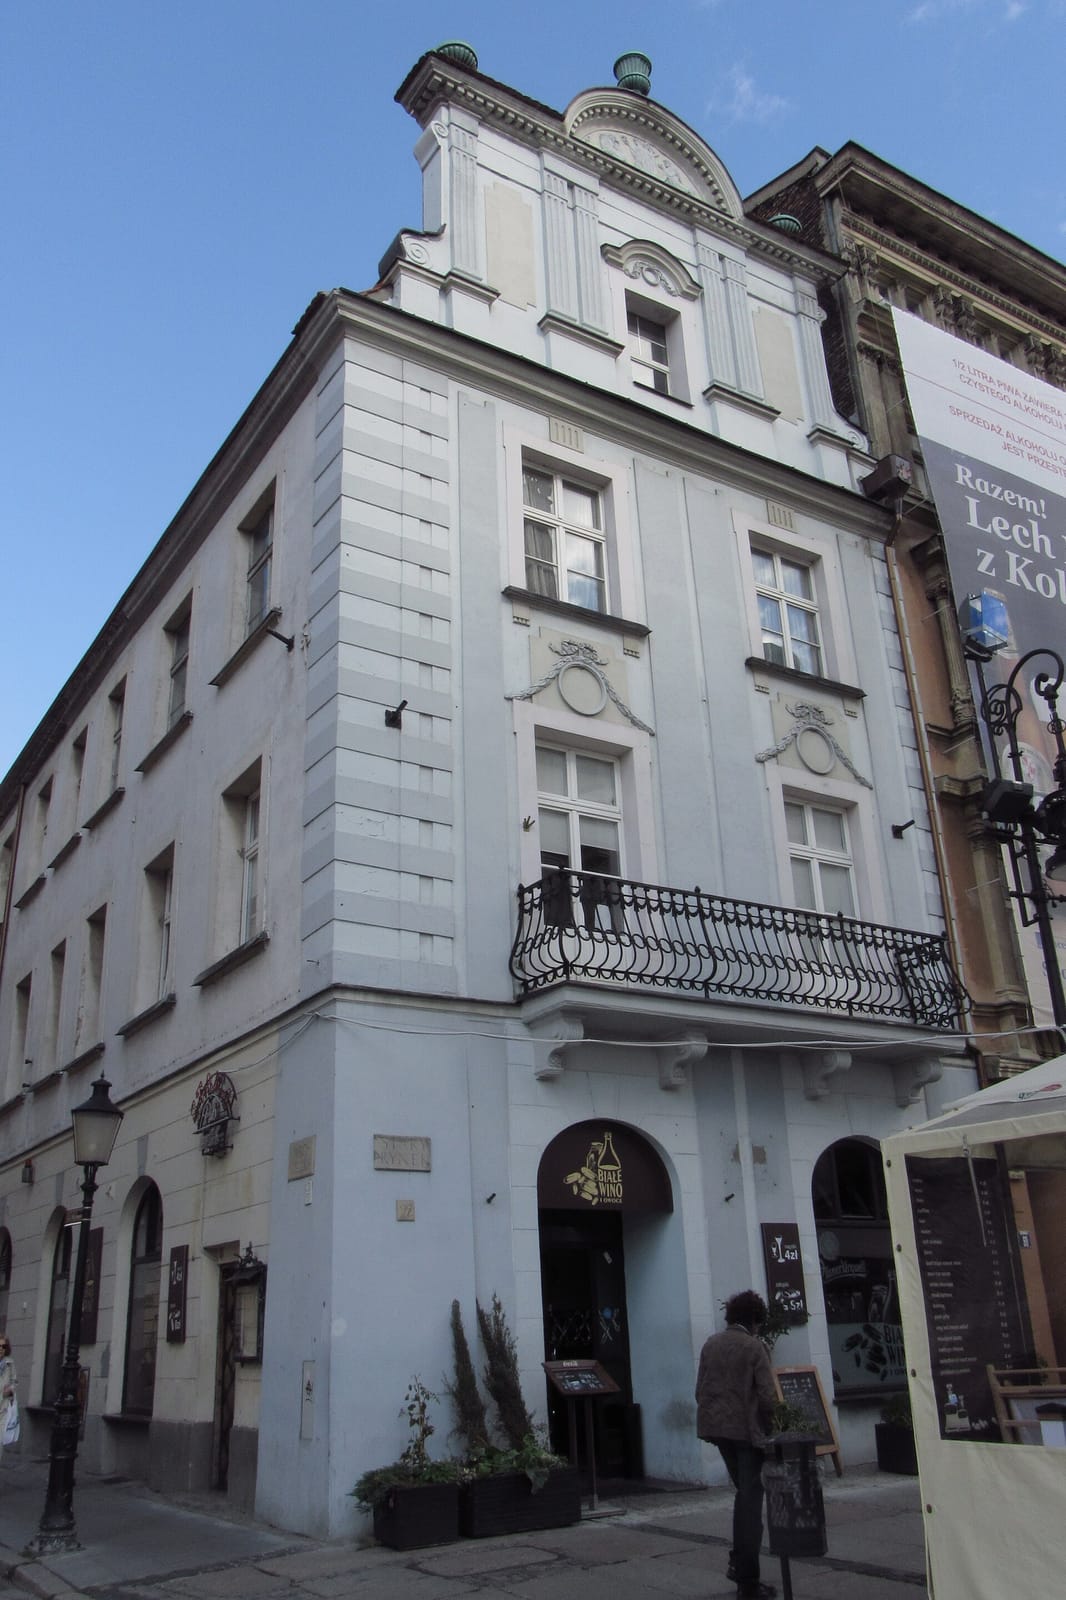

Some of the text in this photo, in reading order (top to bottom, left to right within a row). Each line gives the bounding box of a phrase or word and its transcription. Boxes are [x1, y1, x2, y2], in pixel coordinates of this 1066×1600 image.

[959, 373, 1063, 430] CZYSTEGO ALKOHOLU
[967, 366, 995, 385] LITRA
[997, 379, 1021, 397] PIWA
[1023, 391, 1063, 417] ZAWIERA
[1002, 441, 1025, 459] JEST
[1005, 430, 1058, 461] ALKOHOLU
[954, 463, 1047, 519] Razem!
[965, 495, 1057, 559] Lech
[976, 548, 996, 577] z
[598, 1182, 623, 1198] WINO
